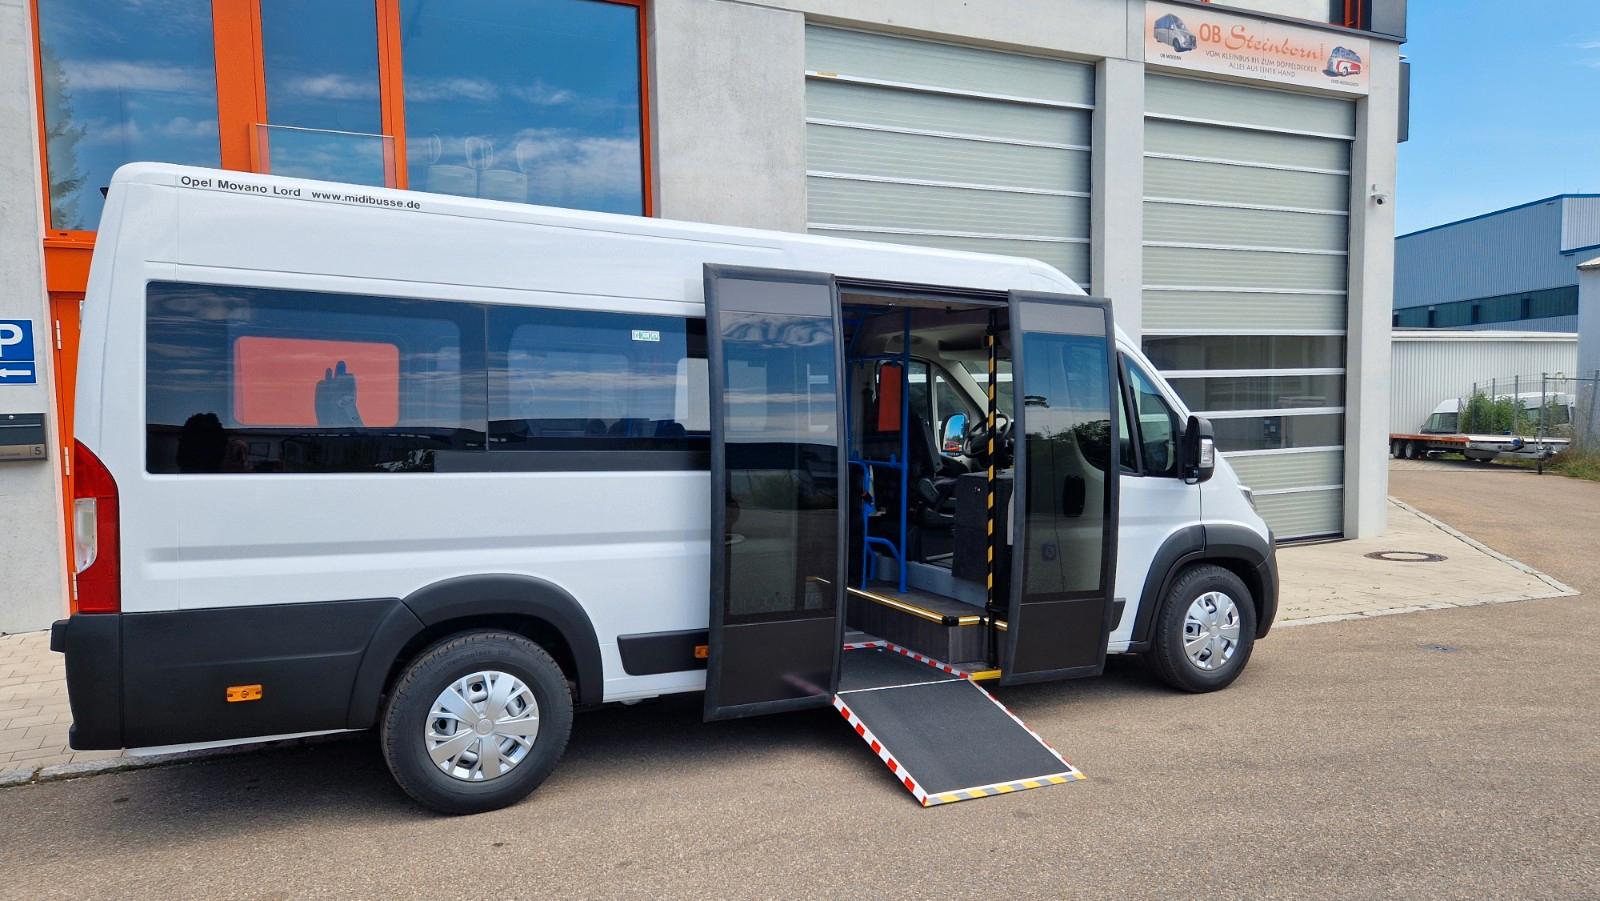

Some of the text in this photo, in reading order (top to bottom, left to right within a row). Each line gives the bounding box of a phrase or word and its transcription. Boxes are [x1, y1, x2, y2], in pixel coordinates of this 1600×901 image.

[1199, 23, 1221, 43] OB
[1225, 25, 1318, 59] Steinborn
[1206, 50, 1220, 58] VOM
[1222, 53, 1250, 62] KLEINBUS
[1261, 58, 1275, 66] ZUM
[1277, 60, 1318, 72] DOPPELDECKER
[1229, 62, 1245, 70] ALLES
[1278, 69, 1296, 77] HAND
[181, 175, 421, 210] Opel Movano Lord www.midibusse.de
[0, 323, 23, 357] P
